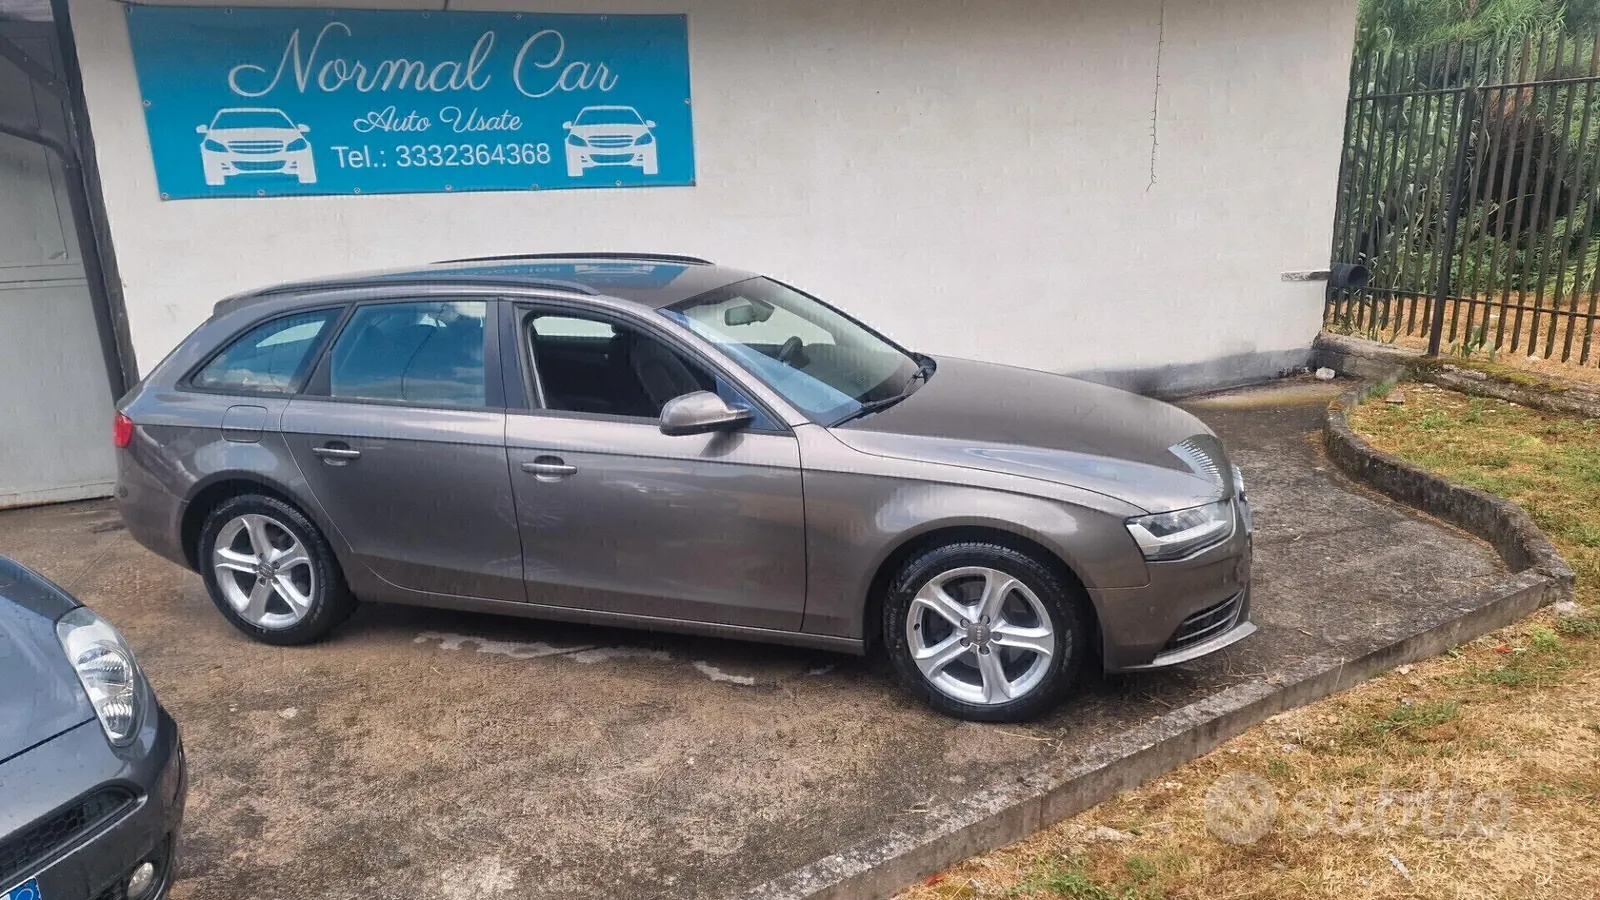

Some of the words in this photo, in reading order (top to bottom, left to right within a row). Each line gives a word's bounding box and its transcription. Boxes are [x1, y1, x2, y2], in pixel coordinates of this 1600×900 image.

[228, 22, 494, 97] Normal
[513, 29, 618, 98] Car
[353, 105, 431, 133] Auto
[439, 106, 523, 133] Usate
[331, 145, 386, 169] Tel.:
[395, 142, 551, 168] 3332364368
